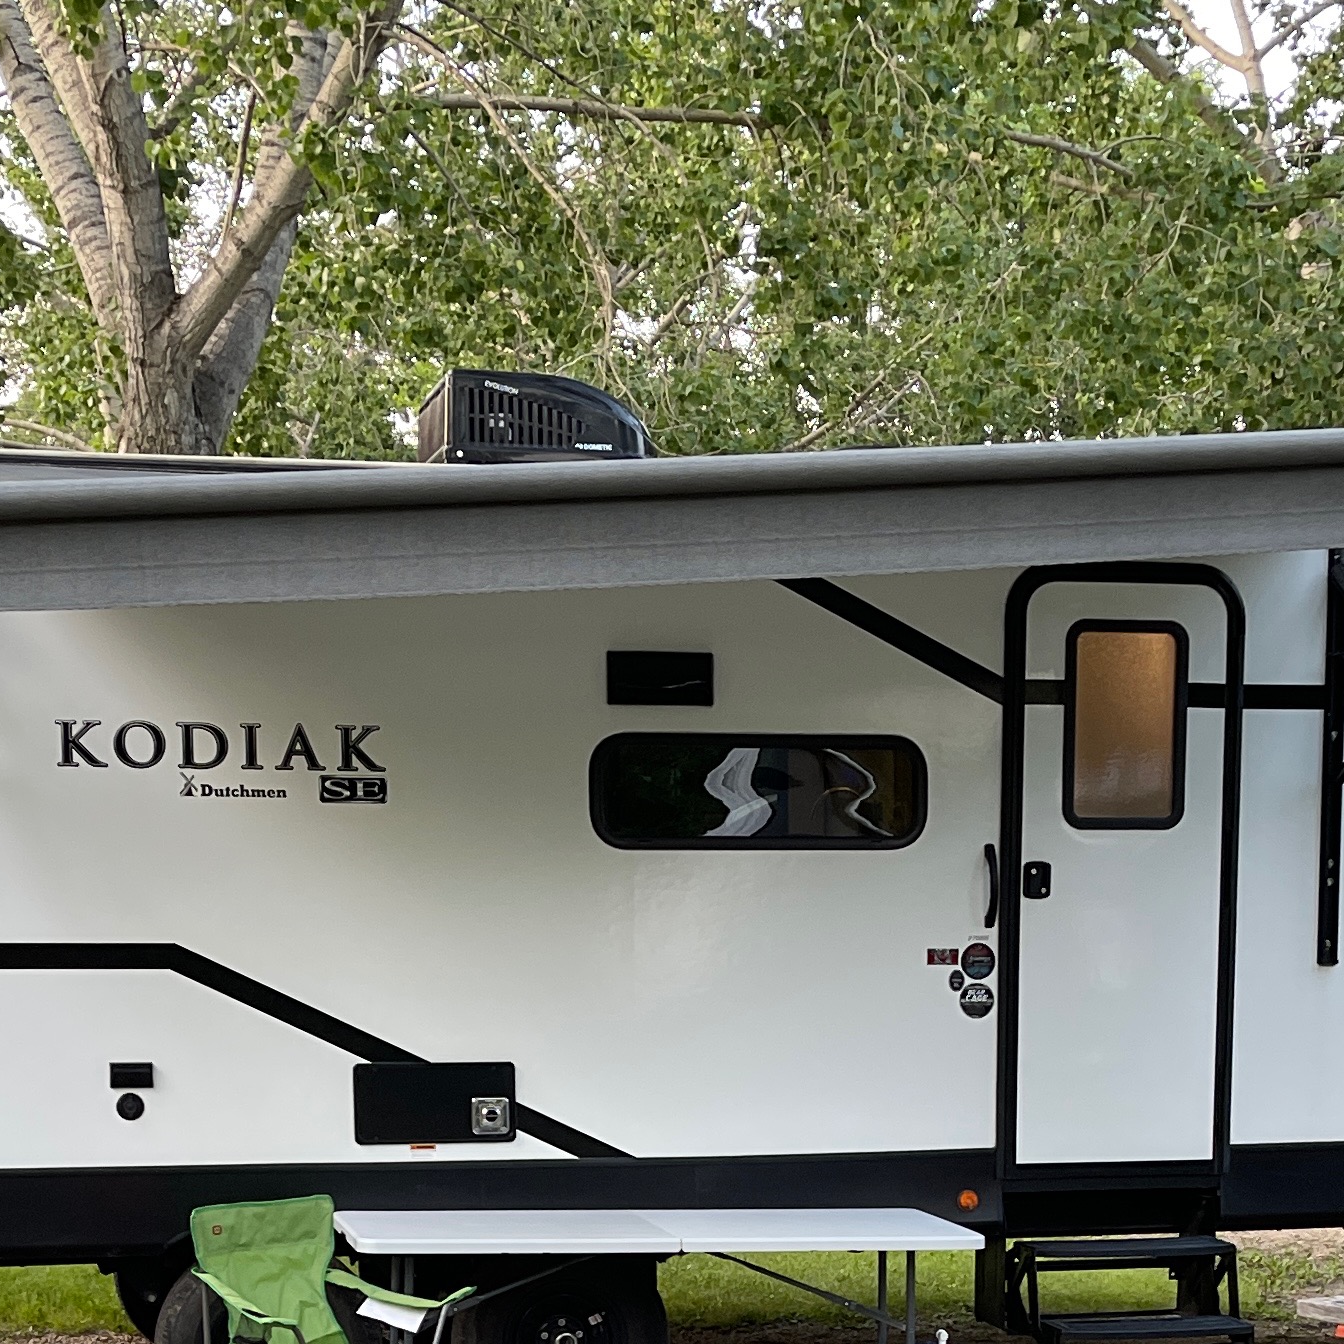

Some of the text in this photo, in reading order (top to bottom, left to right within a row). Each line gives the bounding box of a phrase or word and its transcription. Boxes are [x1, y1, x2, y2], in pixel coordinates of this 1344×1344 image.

[55, 719, 387, 772] KODIAK
[200, 784, 288, 799] Dutchmen
[323, 778, 386, 801] SE
